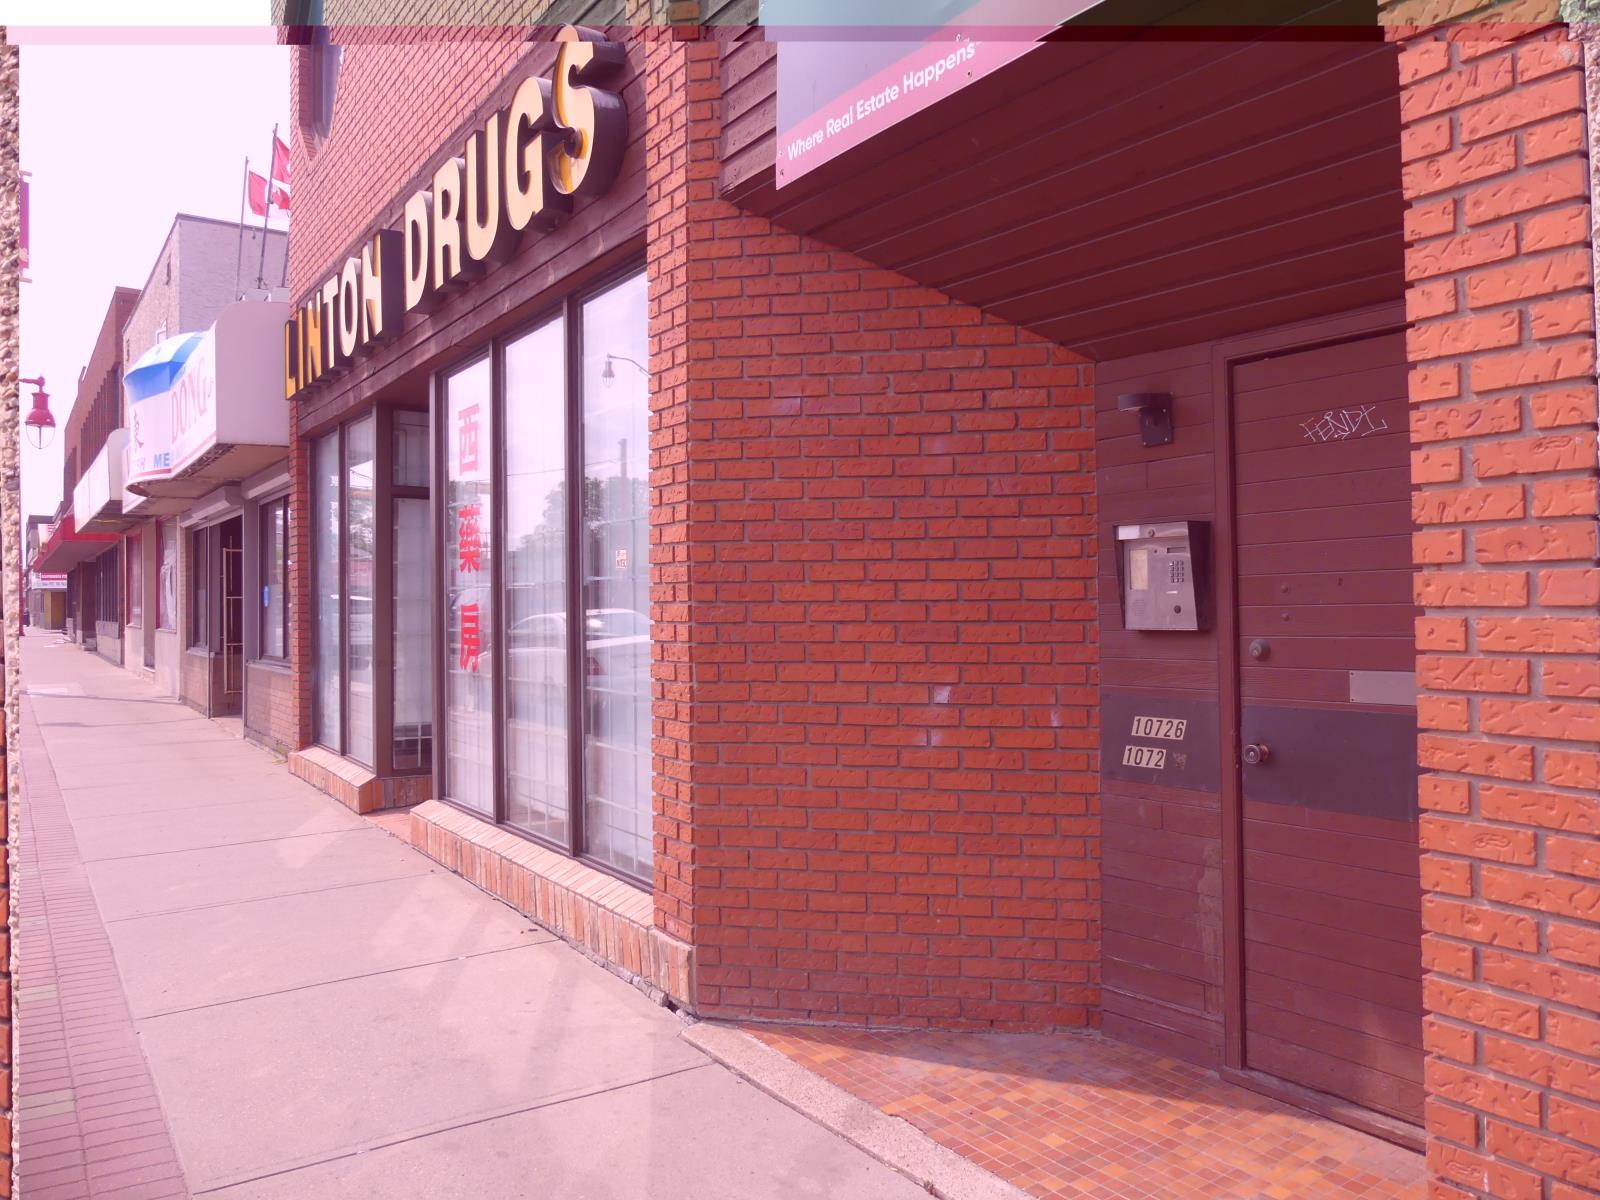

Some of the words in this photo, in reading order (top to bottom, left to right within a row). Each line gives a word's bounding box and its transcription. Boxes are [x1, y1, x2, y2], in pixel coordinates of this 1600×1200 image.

[787, 129, 824, 161] Where
[826, 105, 853, 138] Real
[856, 85, 899, 121] Estate
[903, 41, 976, 94] Happens
[285, 233, 383, 400] LINTON
[404, 25, 596, 313] DRUGS
[458, 402, 481, 673] 西藥房
[1126, 747, 1165, 768] 1072
[1135, 718, 1185, 738] 10726
